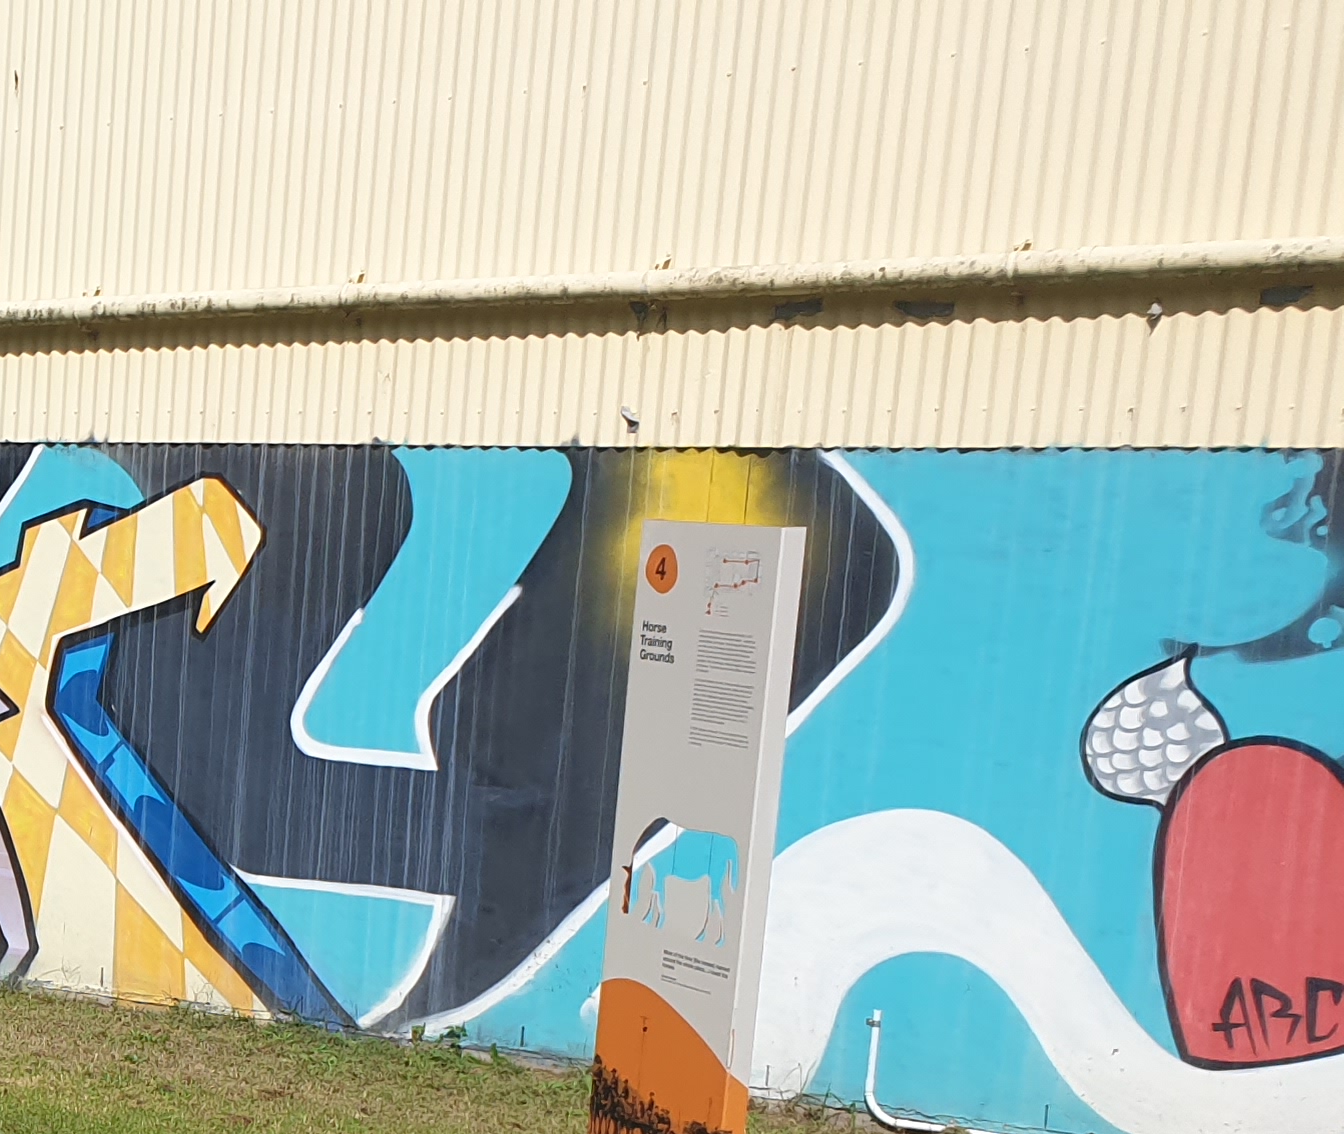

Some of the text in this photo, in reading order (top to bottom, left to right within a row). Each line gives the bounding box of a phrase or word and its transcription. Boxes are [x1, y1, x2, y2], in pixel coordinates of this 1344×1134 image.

[655, 557, 667, 581] 4
[642, 621, 667, 634] Horse
[640, 635, 673, 650] Training
[639, 649, 675, 664] Grounds
